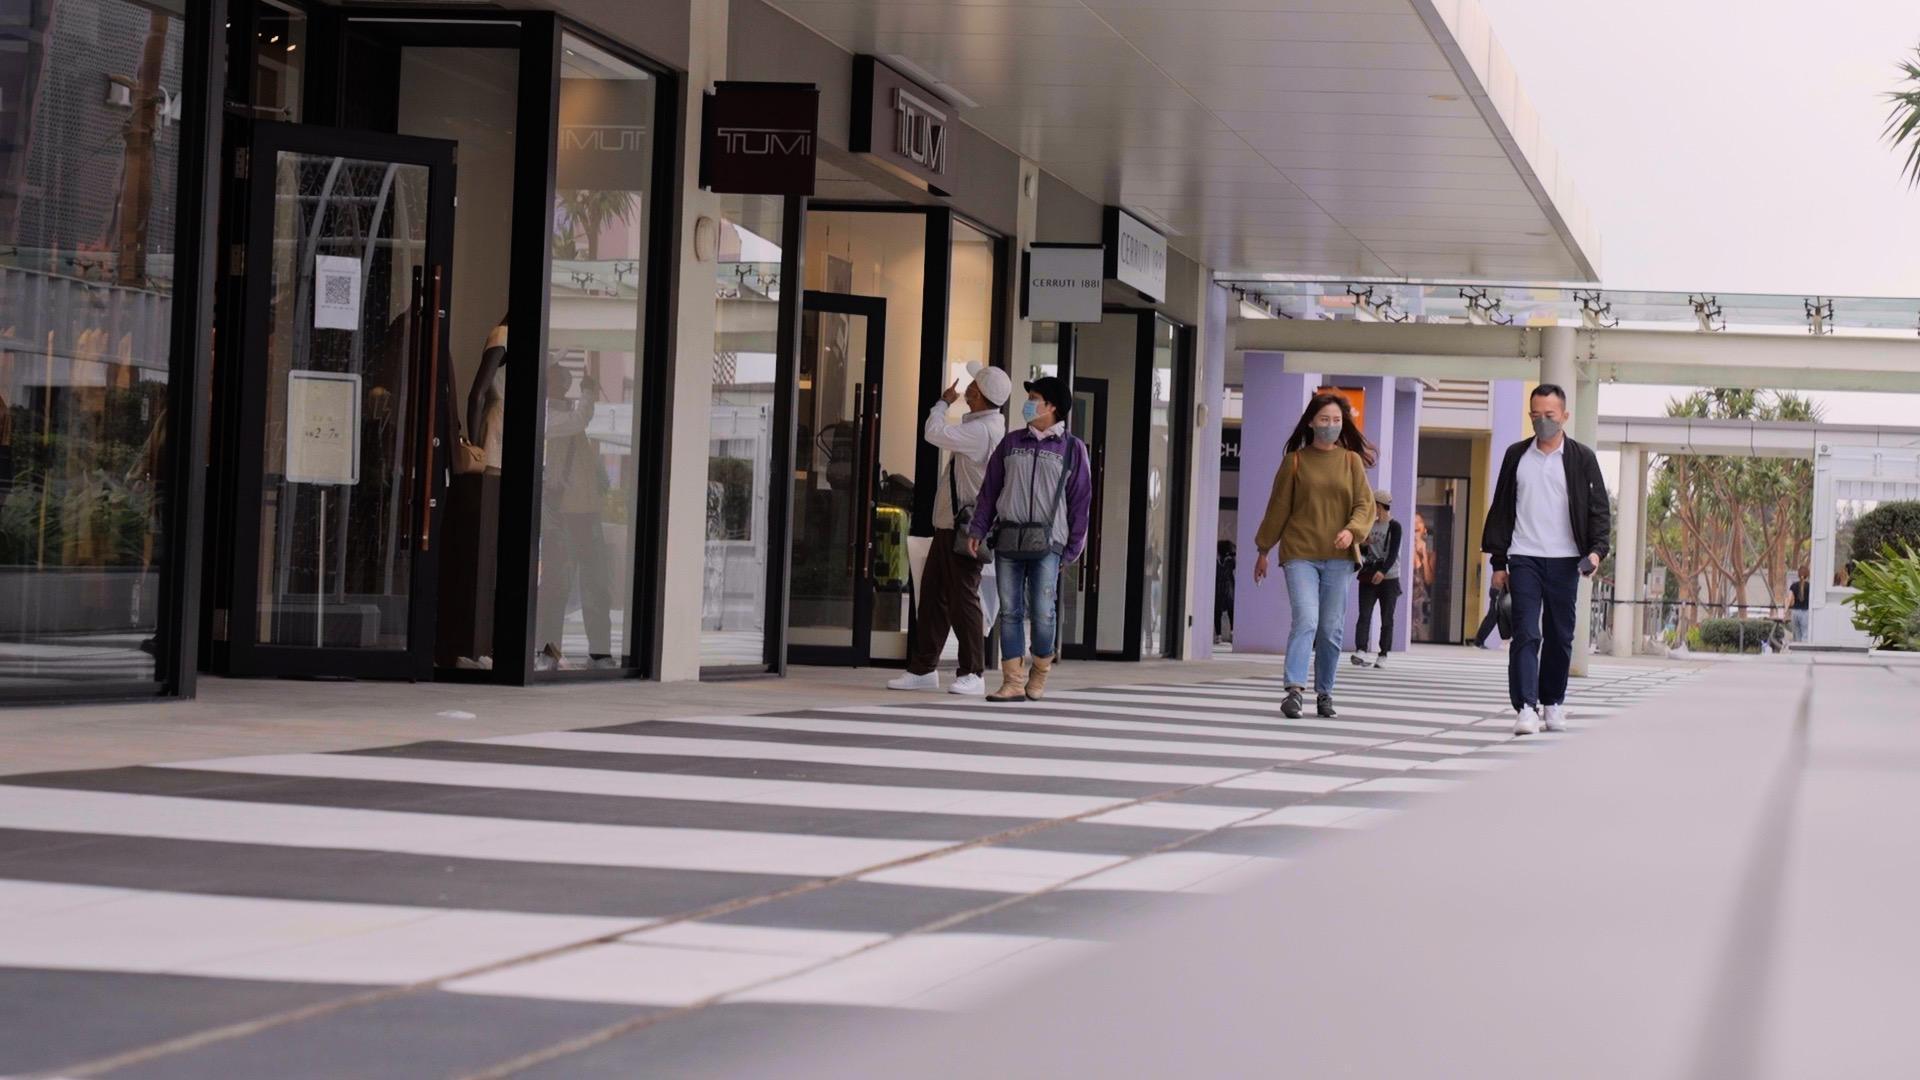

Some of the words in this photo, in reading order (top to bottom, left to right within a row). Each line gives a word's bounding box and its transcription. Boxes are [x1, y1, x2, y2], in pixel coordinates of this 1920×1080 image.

[717, 127, 811, 155] TUMI
[893, 87, 948, 176] TUMI
[1120, 231, 1150, 274] CERRUTI
[1032, 278, 1075, 288] CERRUTI
[1081, 279, 1100, 289] 1881
